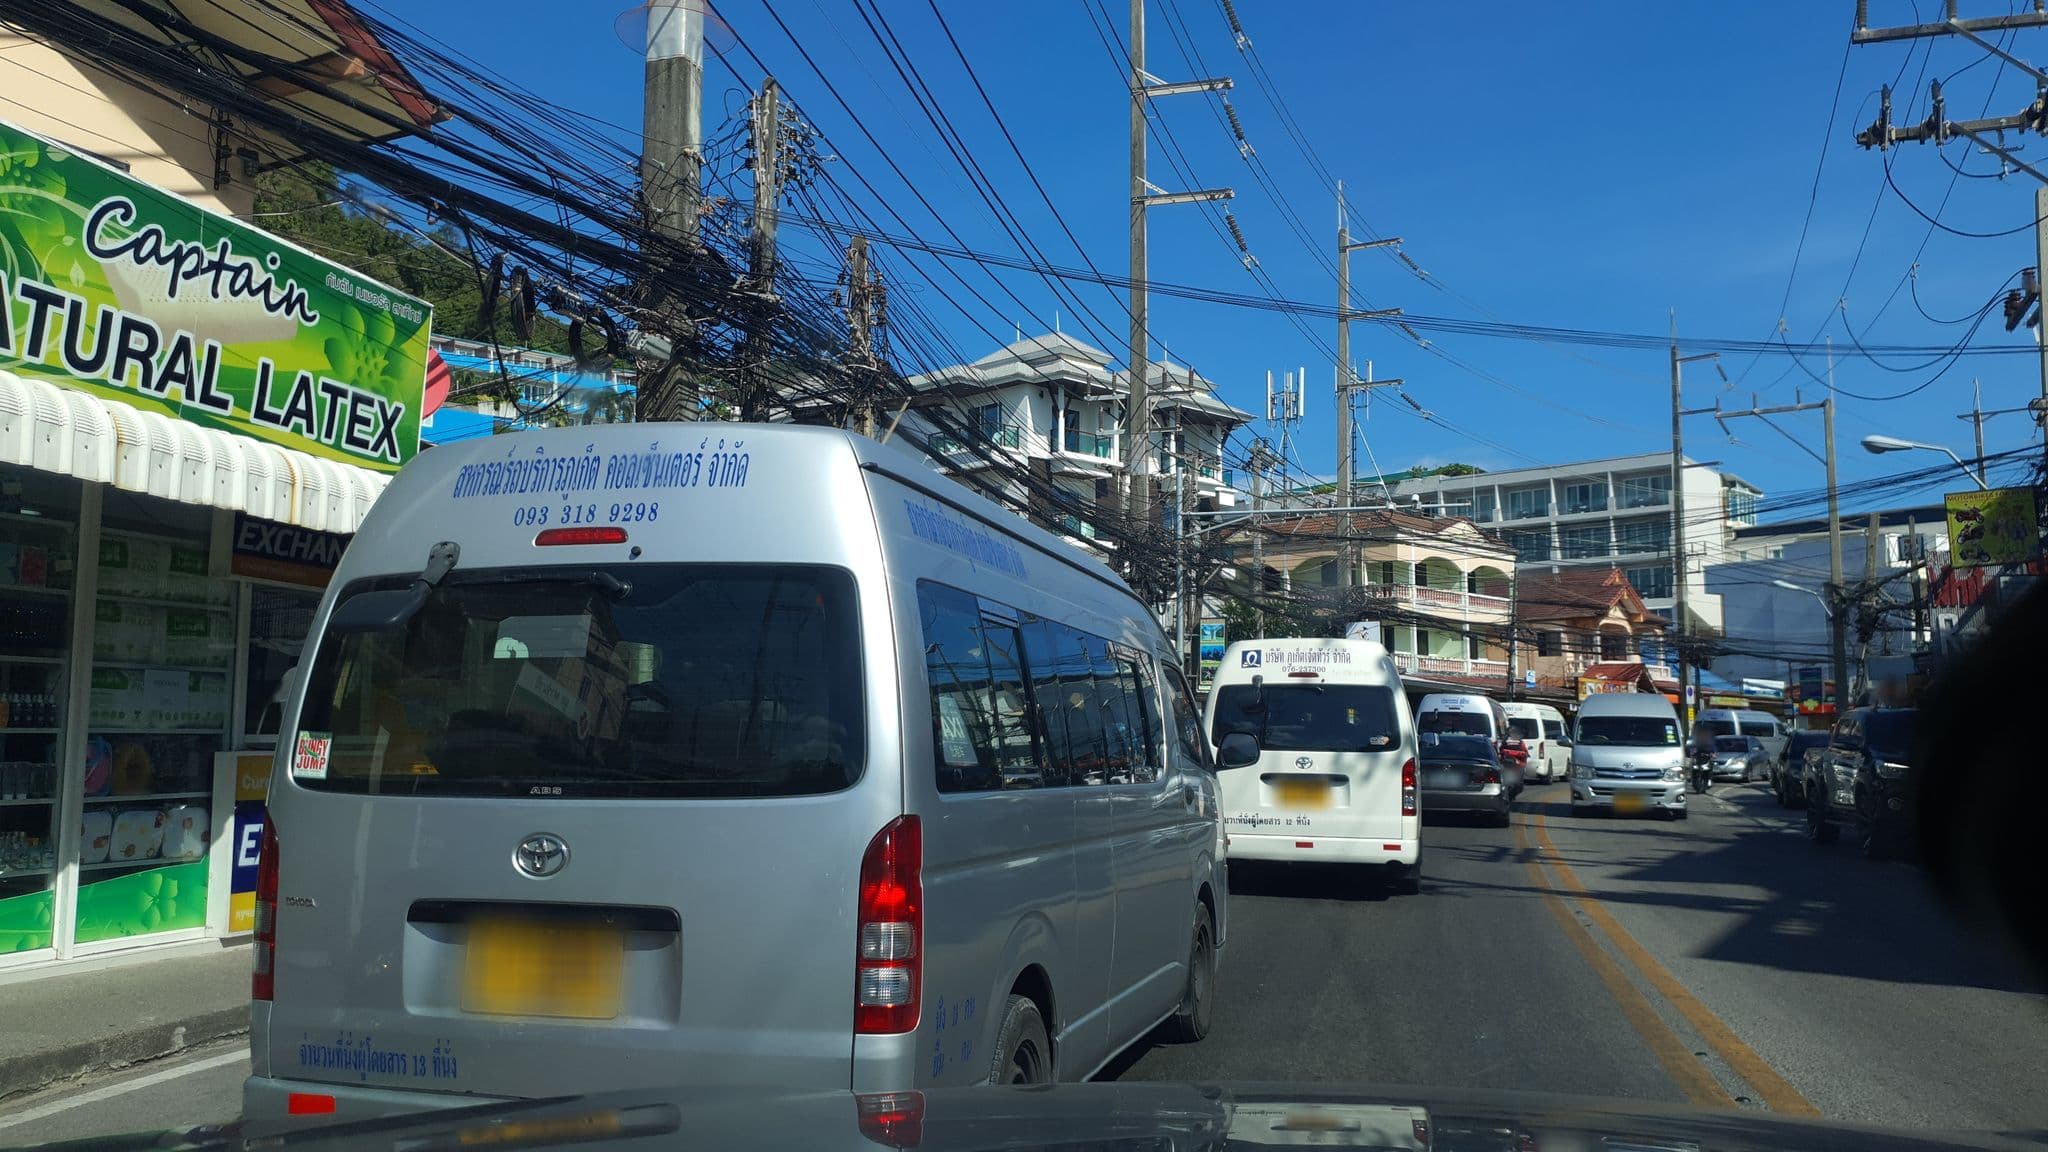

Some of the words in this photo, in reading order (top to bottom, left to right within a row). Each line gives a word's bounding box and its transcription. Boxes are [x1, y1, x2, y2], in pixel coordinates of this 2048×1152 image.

[87, 199, 317, 324] Captain
[0, 270, 232, 412] TURAL
[252, 361, 403, 459] LATEX
[708, 439, 750, 488] จำกัด
[513, 506, 549, 528] 093
[560, 504, 596, 525] 318
[608, 502, 660, 523] 9298
[238, 521, 347, 566] EXCHAN
[296, 755, 326, 770] JUMP
[412, 1054, 427, 1078] 13
[432, 1038, 458, 1079] ที่นั่ง
